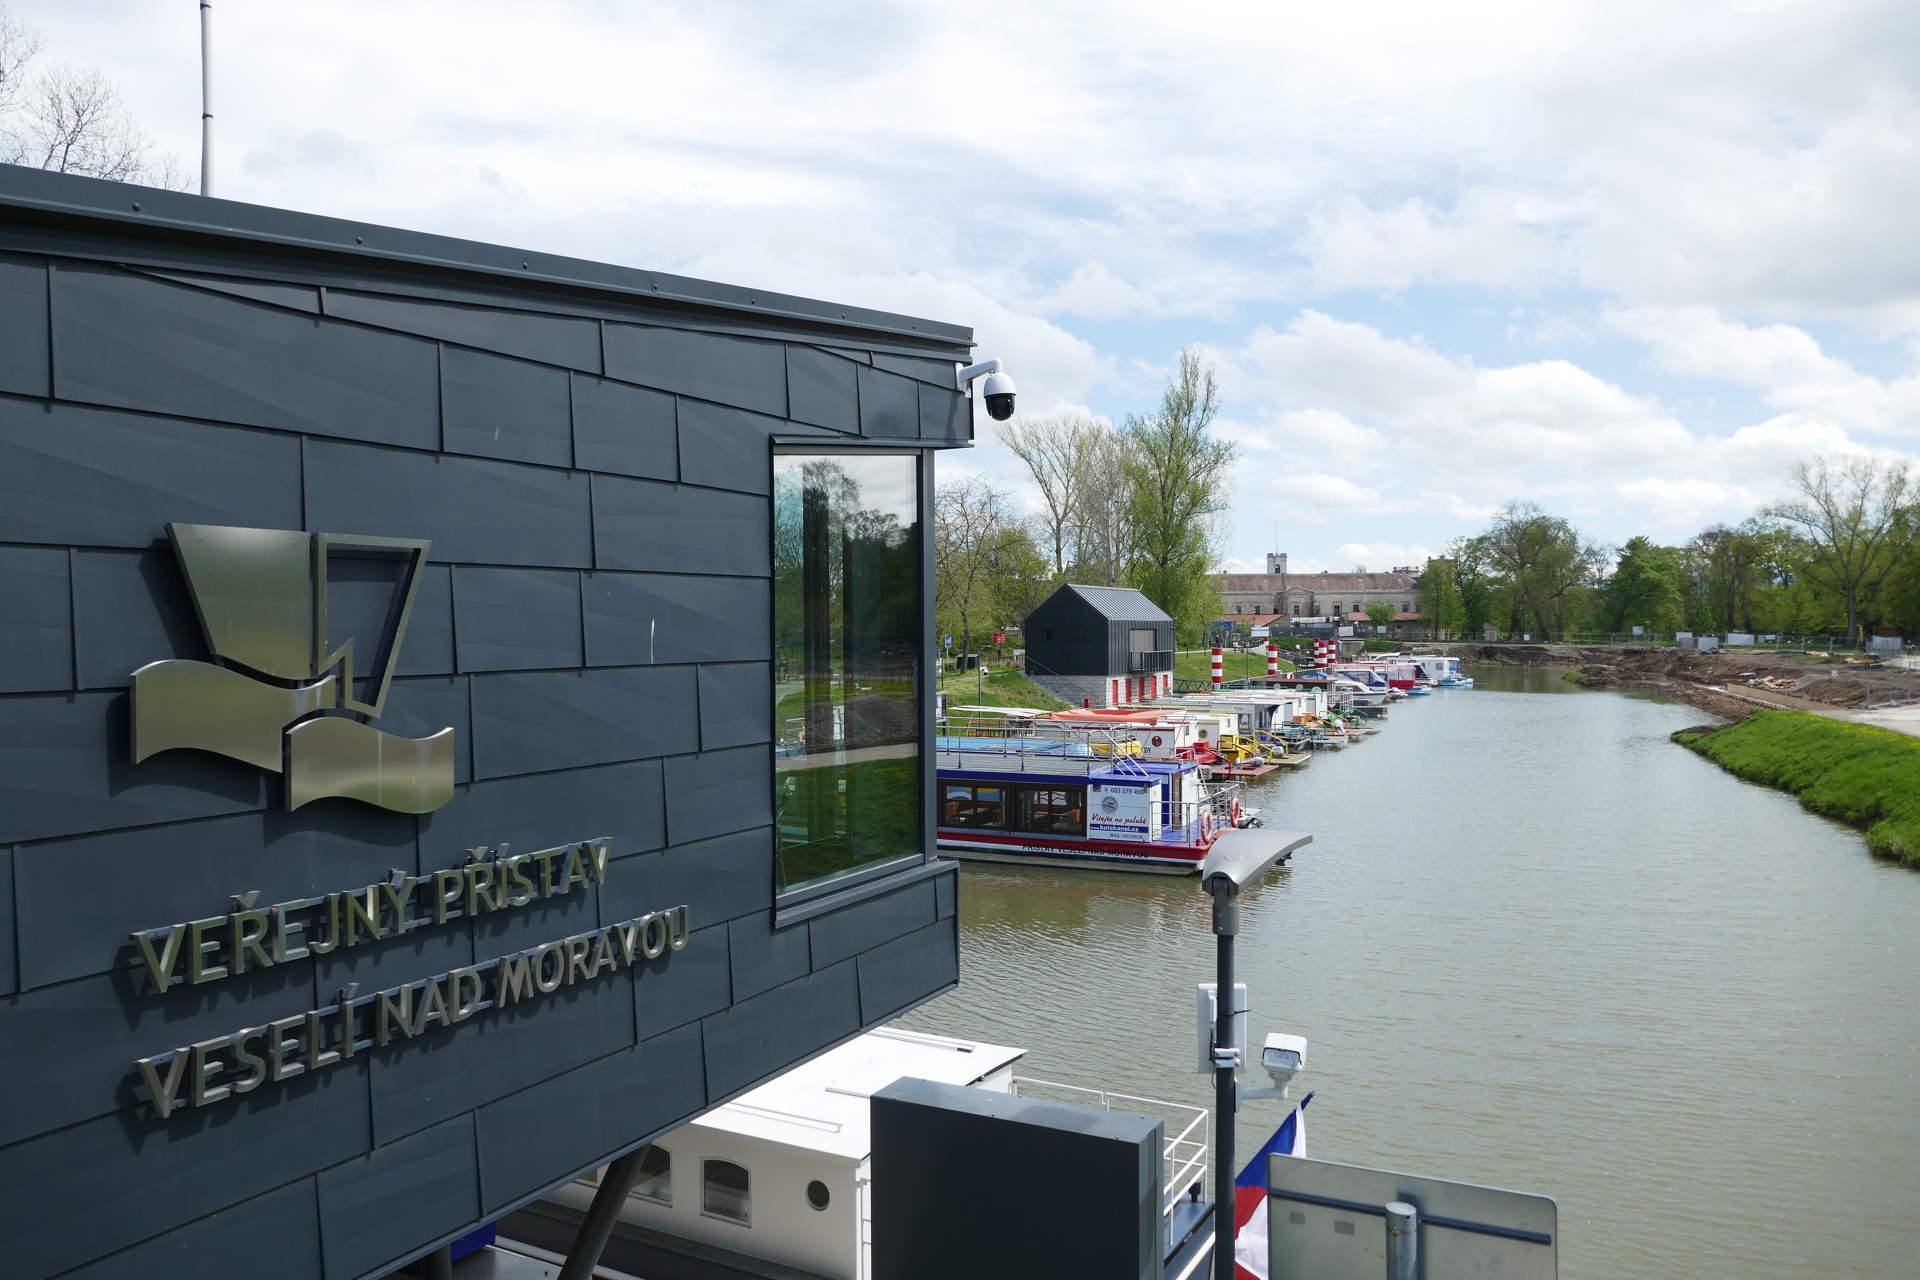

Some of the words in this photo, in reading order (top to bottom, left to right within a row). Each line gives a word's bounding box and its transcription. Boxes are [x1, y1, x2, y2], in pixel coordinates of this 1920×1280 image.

[132, 868, 416, 993] VEŘEJNÝ
[433, 836, 613, 924] PŘÍSTAV
[136, 982, 361, 1118] VESELÍ
[375, 967, 484, 1047] NAD
[498, 904, 690, 1008] MORAVOU
